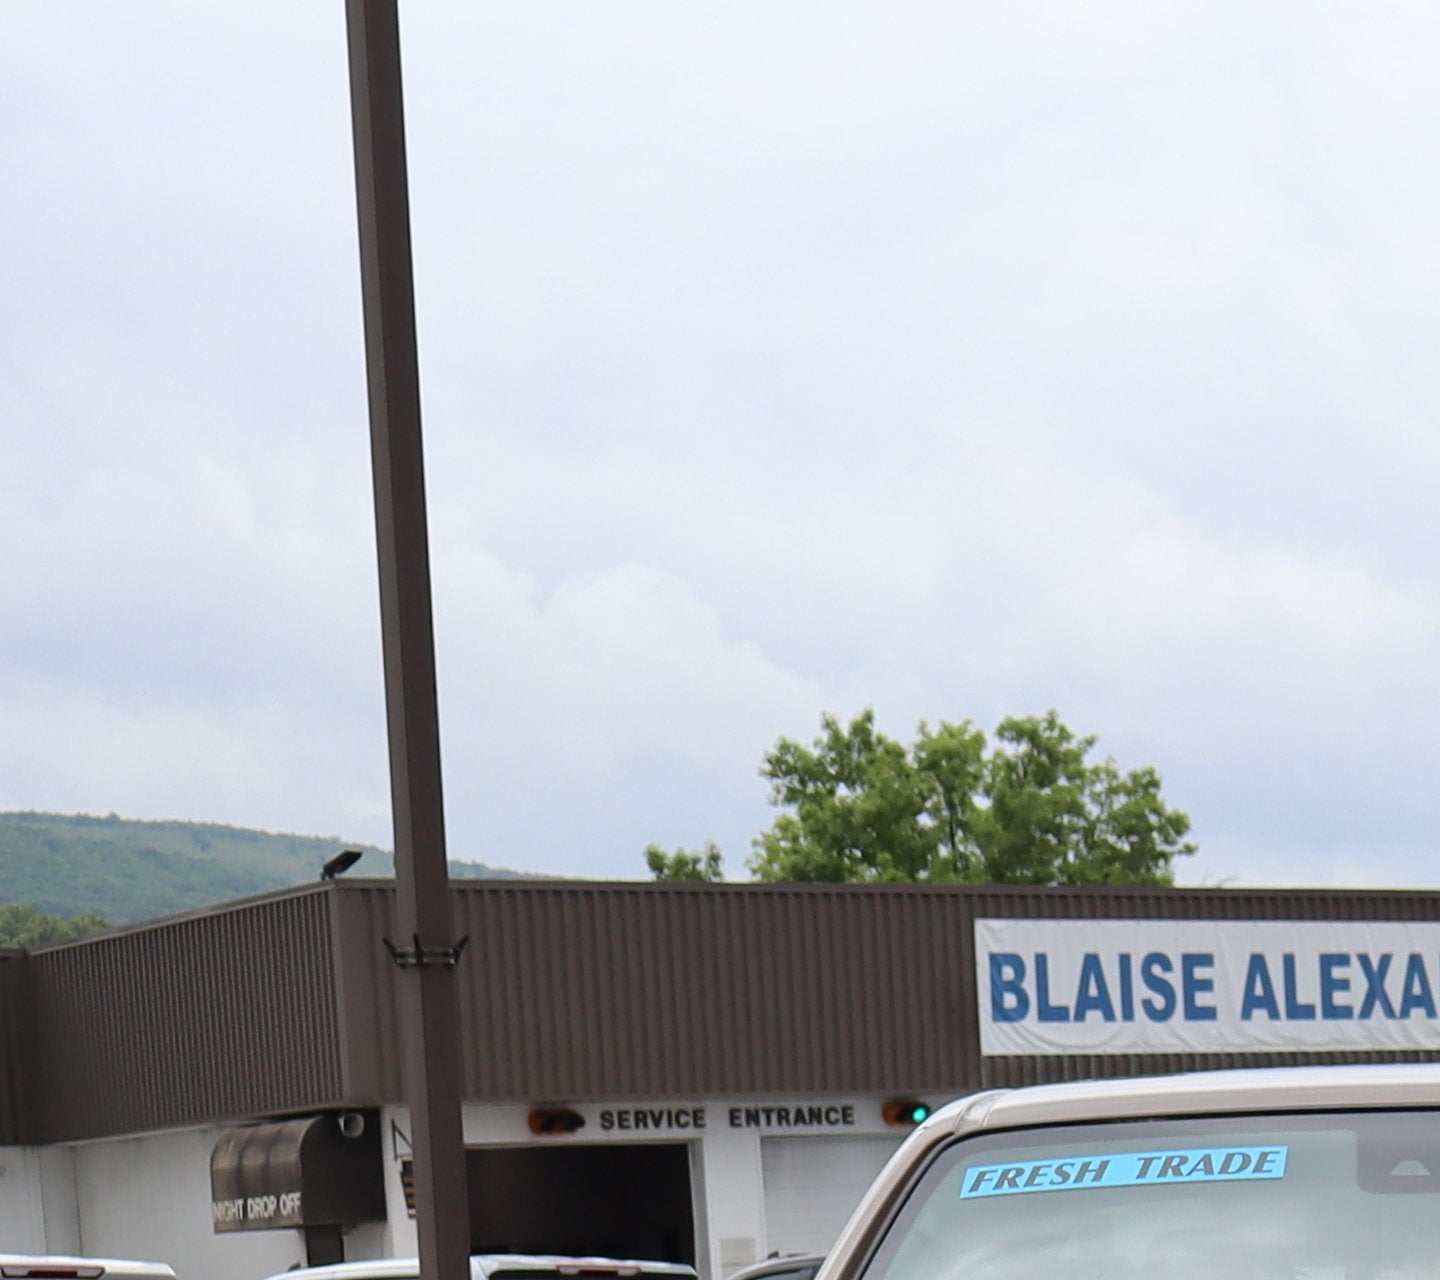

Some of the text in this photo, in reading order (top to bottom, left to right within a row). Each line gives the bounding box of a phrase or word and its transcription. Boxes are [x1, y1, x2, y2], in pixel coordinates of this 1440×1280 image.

[988, 952, 1217, 1022] BLAISE
[600, 1105, 855, 1130] SERVICE ENTRANCE
[968, 1150, 1281, 1193] FRESH TRADE
[247, 1195, 277, 1219] DROP
[280, 1192, 302, 1216] OFF
